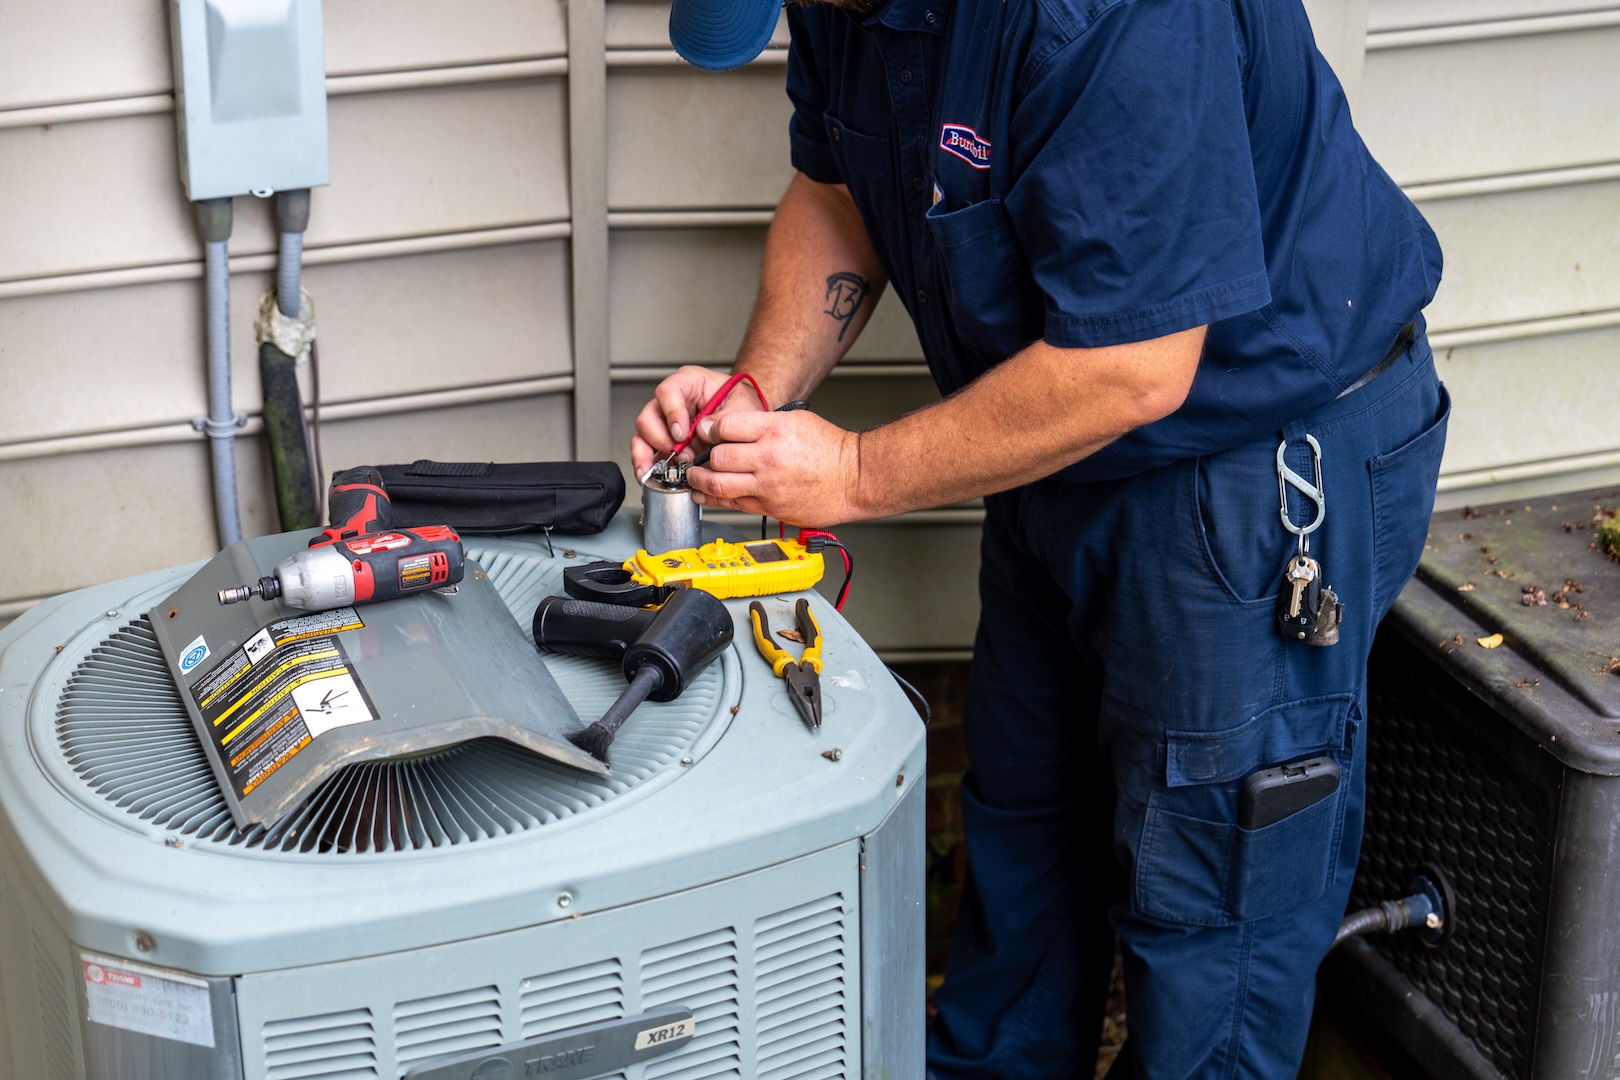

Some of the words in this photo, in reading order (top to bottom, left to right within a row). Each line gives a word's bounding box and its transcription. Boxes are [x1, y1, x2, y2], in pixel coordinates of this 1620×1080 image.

[250, 667, 283, 694] CAUTION
[259, 685, 292, 712] CAUTION
[274, 731, 309, 762] HAZARDOUS
[245, 760, 274, 786] VOLTAGE!
[251, 752, 292, 788] WARNING
[107, 972, 135, 985] TRANE
[647, 1024, 685, 1045] XR12
[525, 1045, 595, 1076] TRANE
